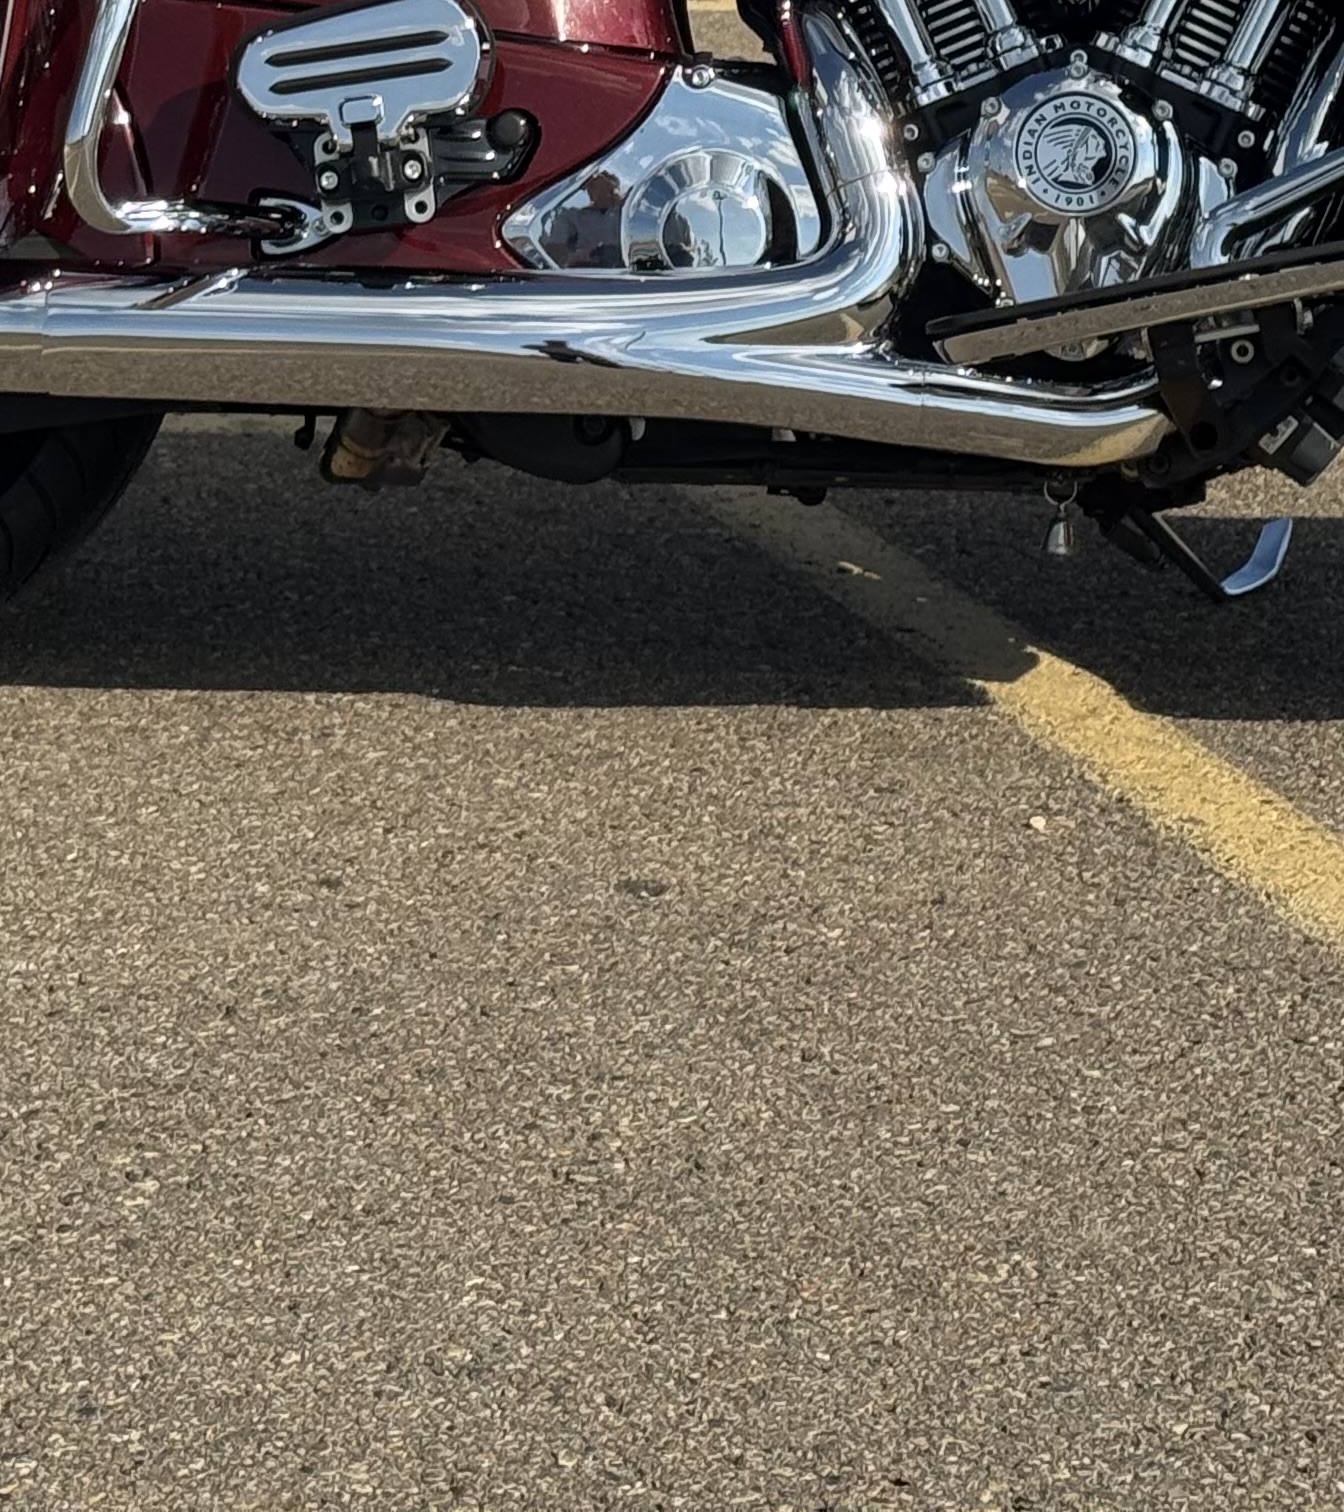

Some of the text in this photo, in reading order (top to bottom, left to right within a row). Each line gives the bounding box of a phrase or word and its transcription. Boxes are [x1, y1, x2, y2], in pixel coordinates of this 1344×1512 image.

[1022, 99, 1130, 187] INDIAN MOTORCYCLE
[1054, 193, 1095, 207] 1901
